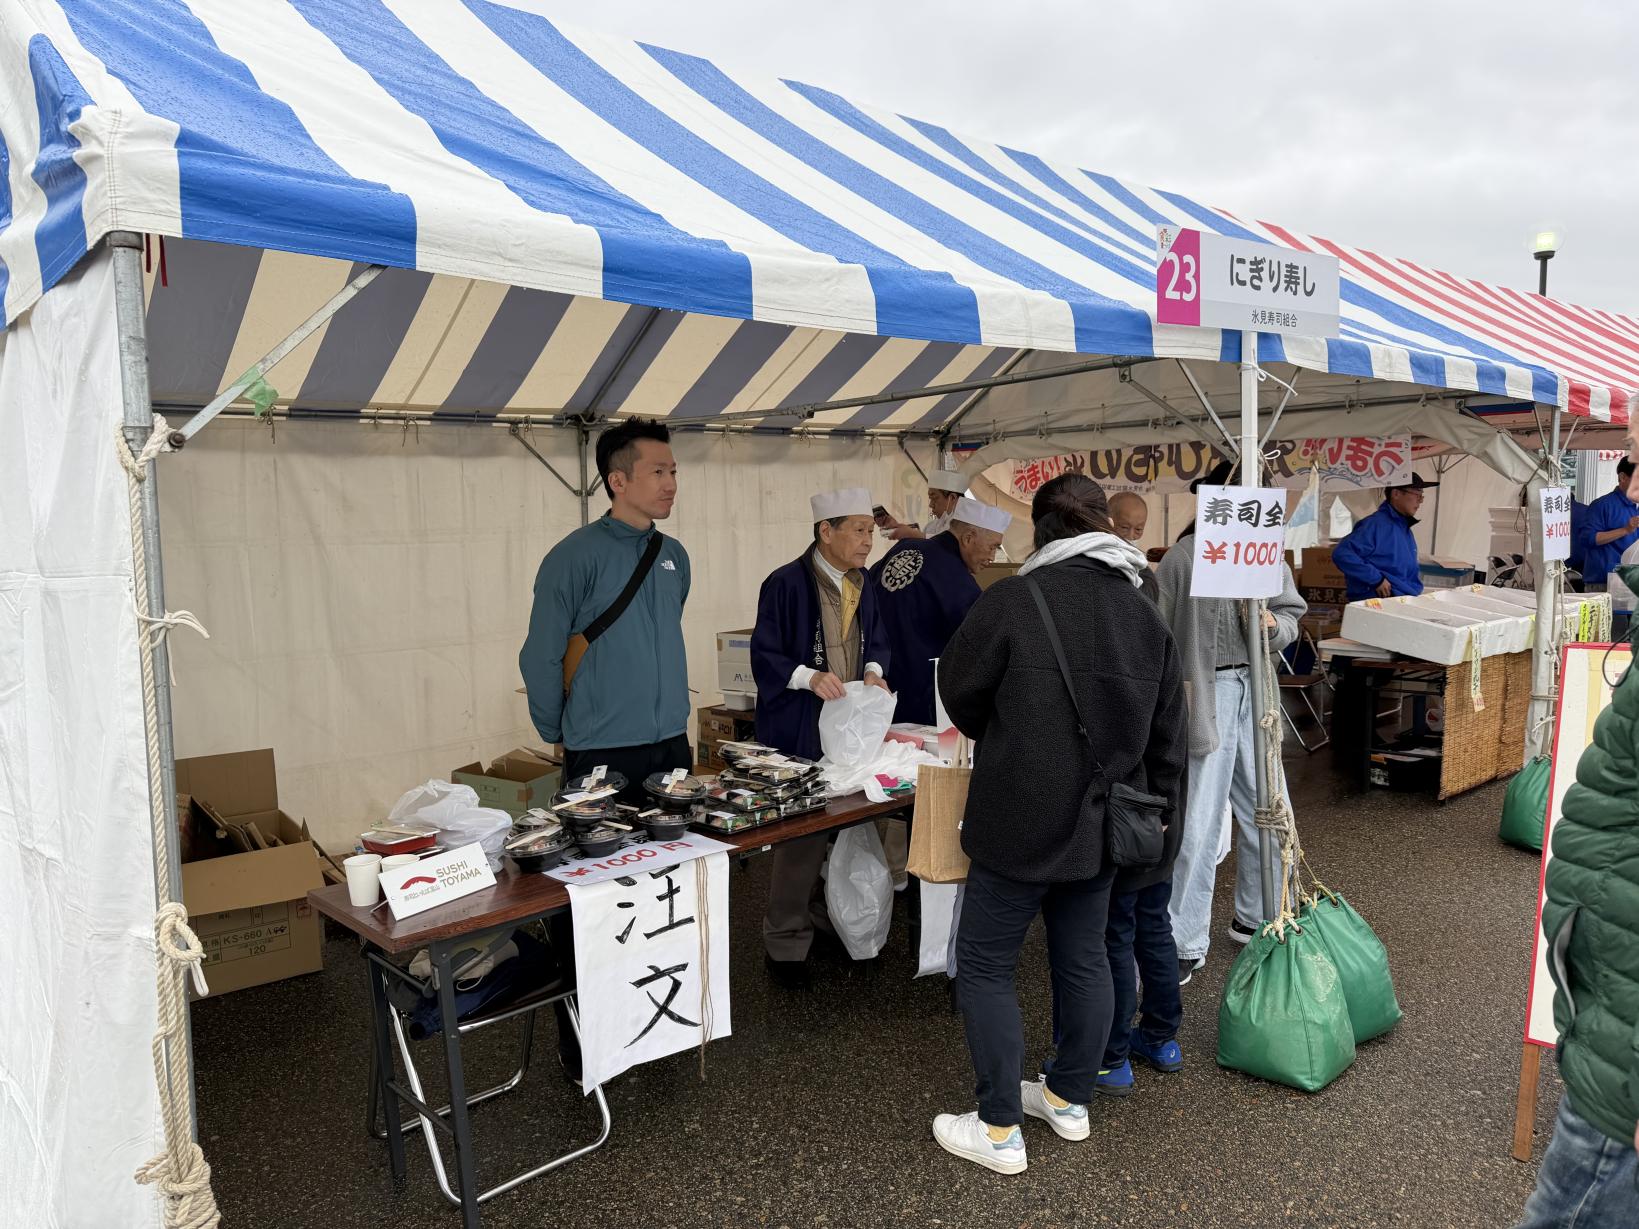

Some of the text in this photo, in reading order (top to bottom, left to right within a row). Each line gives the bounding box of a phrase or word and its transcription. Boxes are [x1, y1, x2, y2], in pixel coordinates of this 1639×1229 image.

[1165, 251, 1197, 302] 23
[1229, 253, 1316, 297] にぎり寿し
[1251, 309, 1298, 328] 氷見寿司組合
[435, 860, 468, 879] SUSHI
[440, 867, 482, 888] TOYAMA
[249, 944, 266, 956] 120
[614, 863, 702, 1049] 注文
